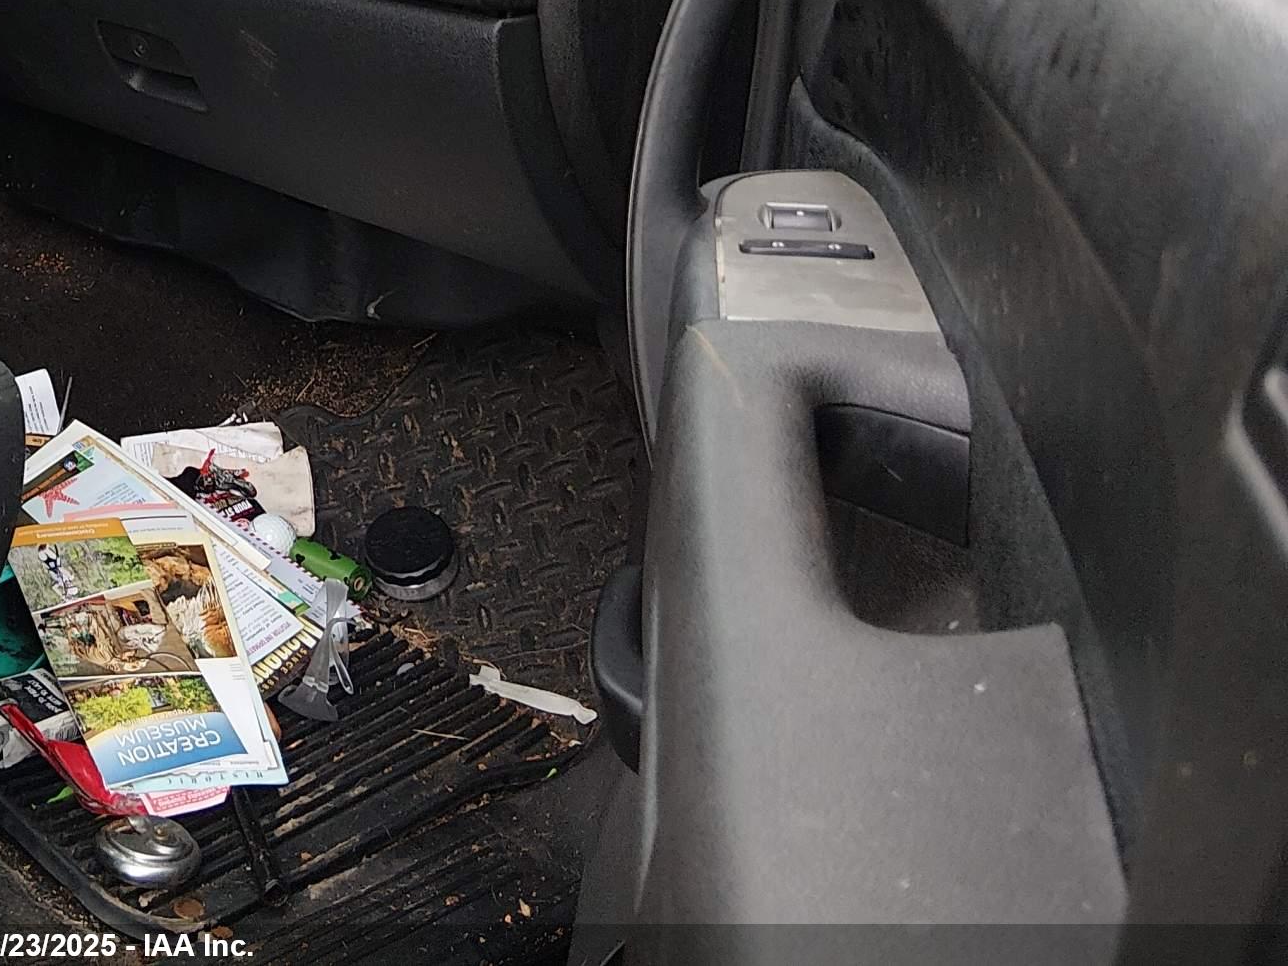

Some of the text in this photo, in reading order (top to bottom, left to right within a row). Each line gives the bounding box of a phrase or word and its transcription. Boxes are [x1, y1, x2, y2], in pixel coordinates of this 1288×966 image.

[280, 648, 308, 675] SINCE
[114, 714, 208, 746] MUSEUM
[117, 728, 222, 767] CREATION
